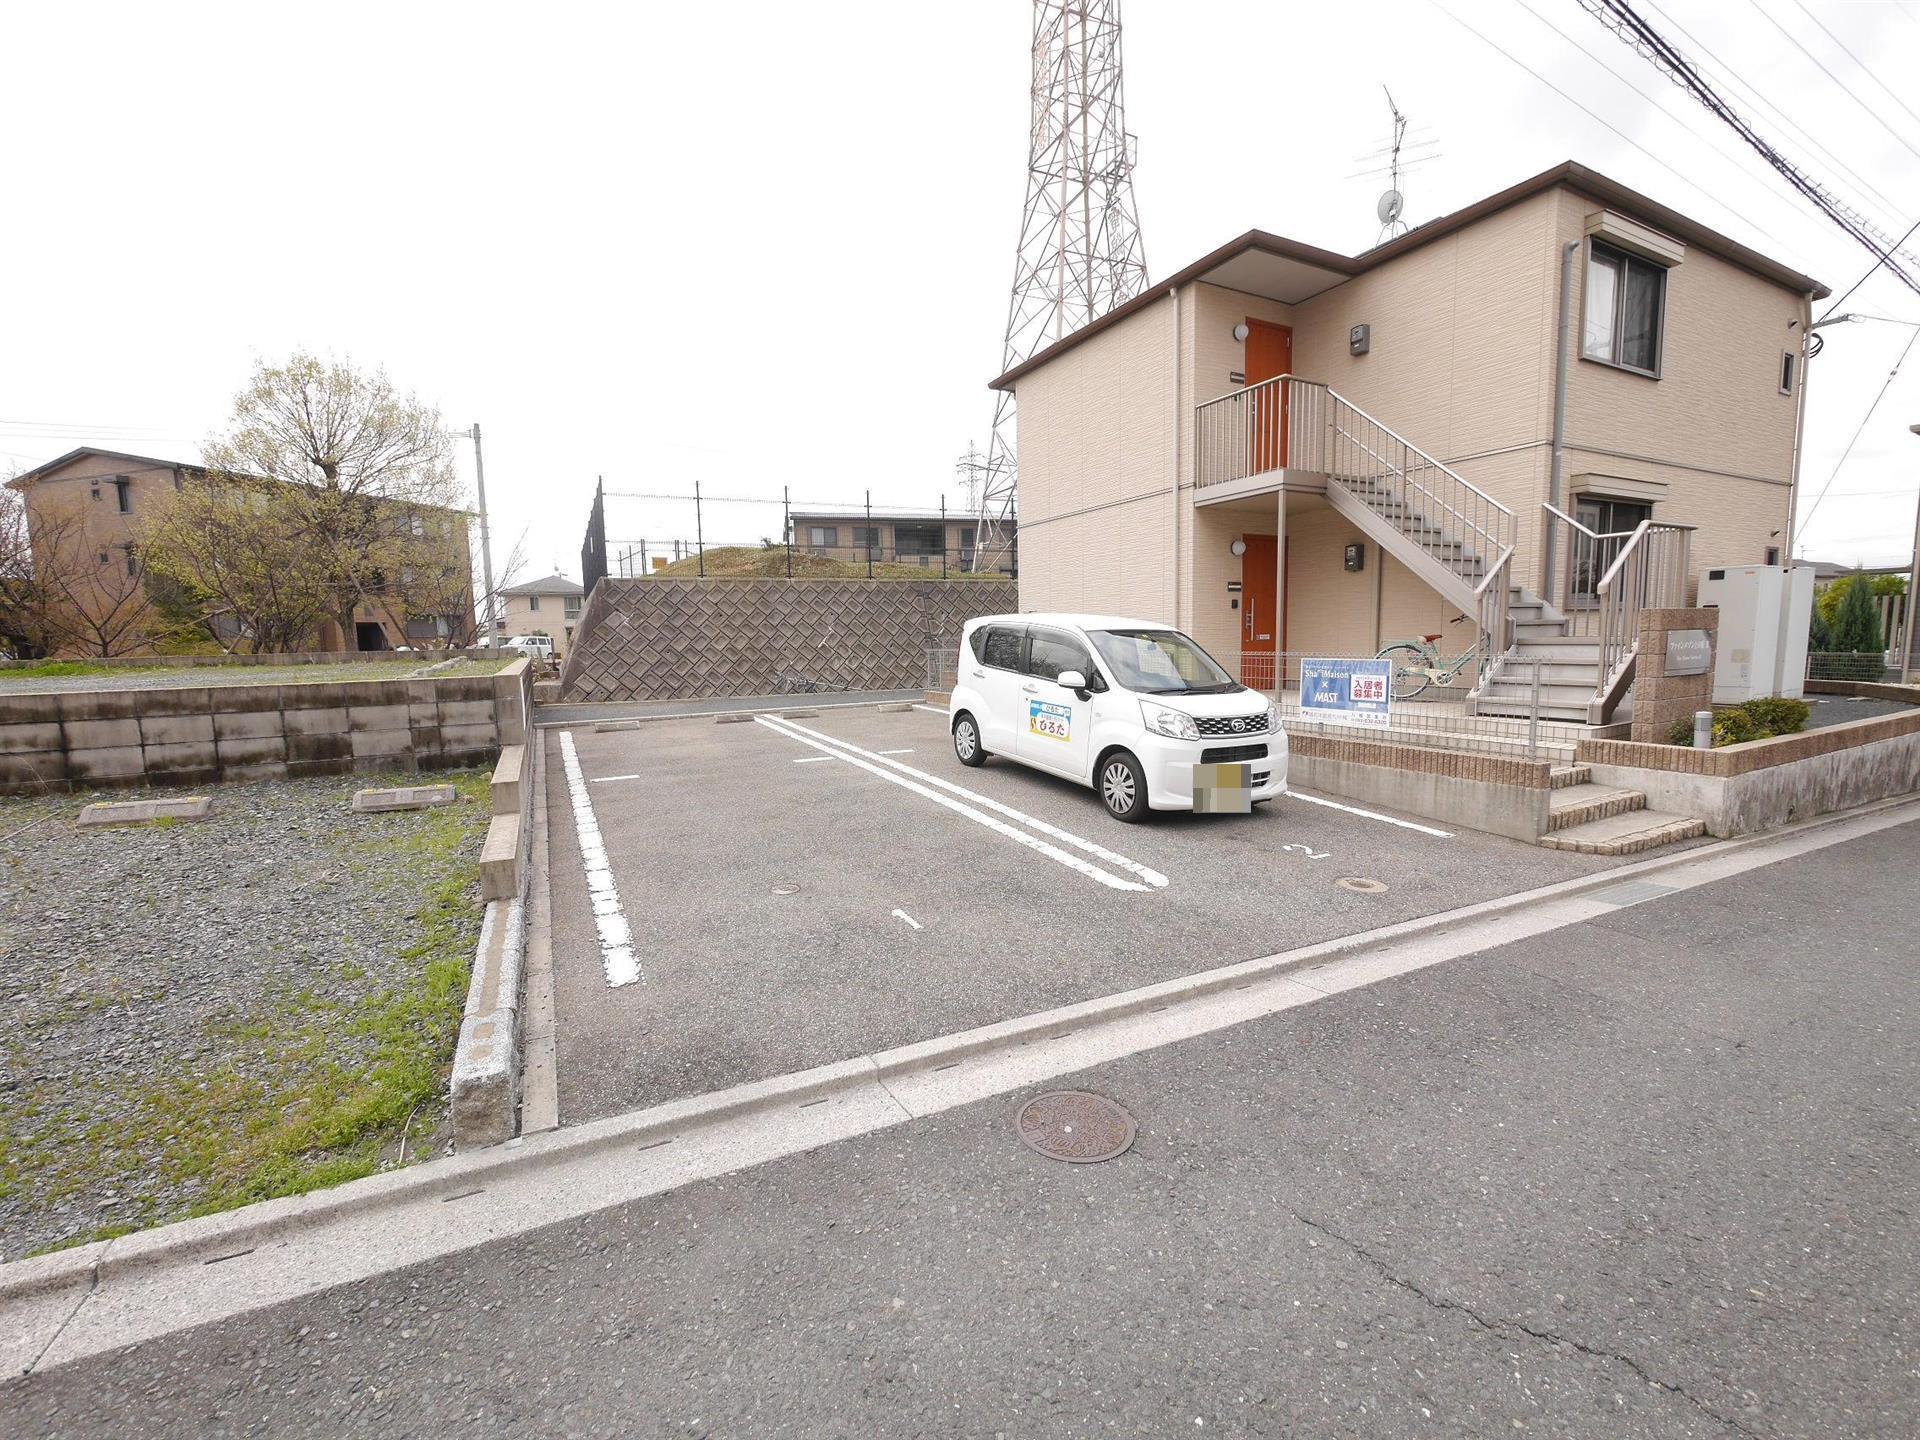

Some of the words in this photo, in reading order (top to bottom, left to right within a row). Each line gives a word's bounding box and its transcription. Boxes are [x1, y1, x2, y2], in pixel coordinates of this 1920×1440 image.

[1354, 680, 1383, 690] 入居者
[1314, 692, 1338, 703] MAST
[1354, 689, 1383, 699] 募集中
[1039, 719, 1065, 736] ひろた
